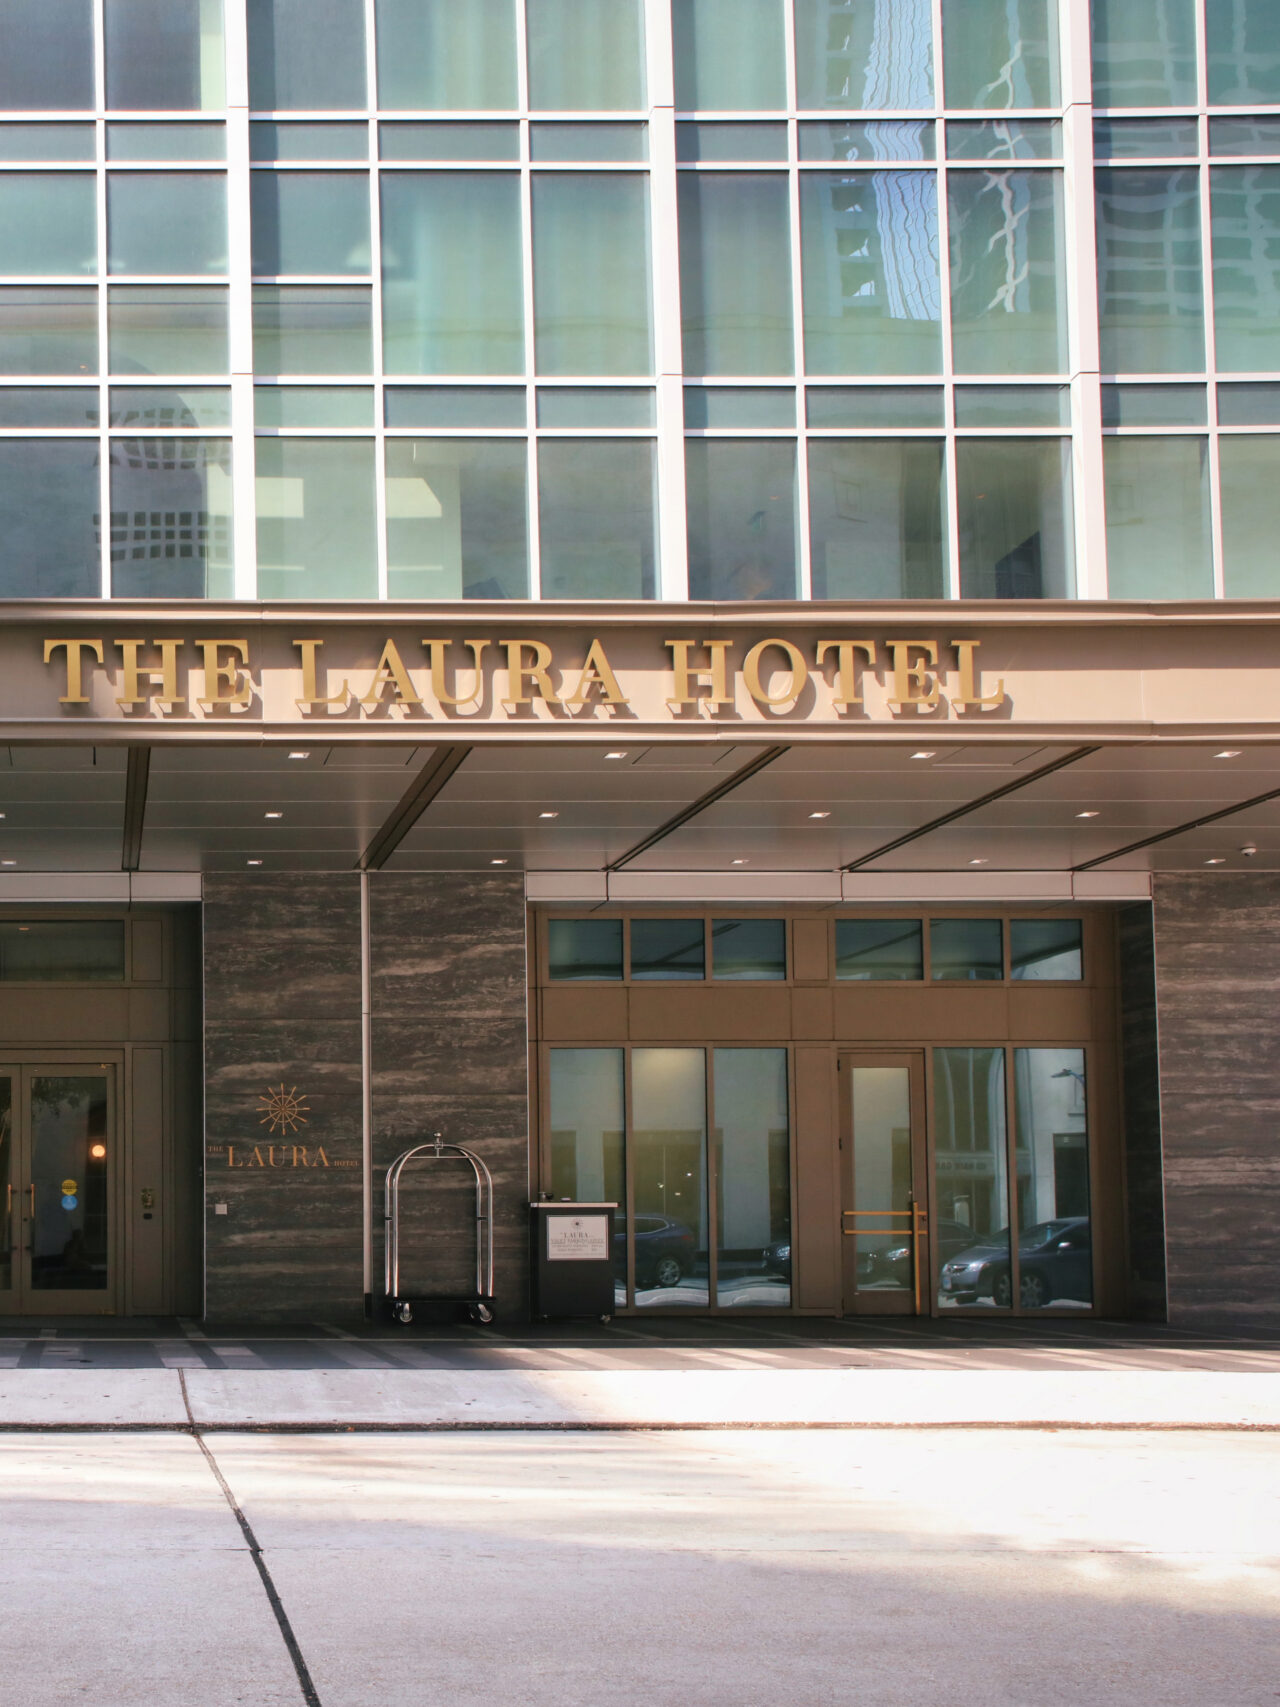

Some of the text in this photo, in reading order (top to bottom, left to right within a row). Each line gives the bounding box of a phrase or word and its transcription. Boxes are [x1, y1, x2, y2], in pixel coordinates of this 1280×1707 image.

[44, 637, 1004, 705] THE LAURA HOTEL
[227, 1145, 330, 1168] LAURA
